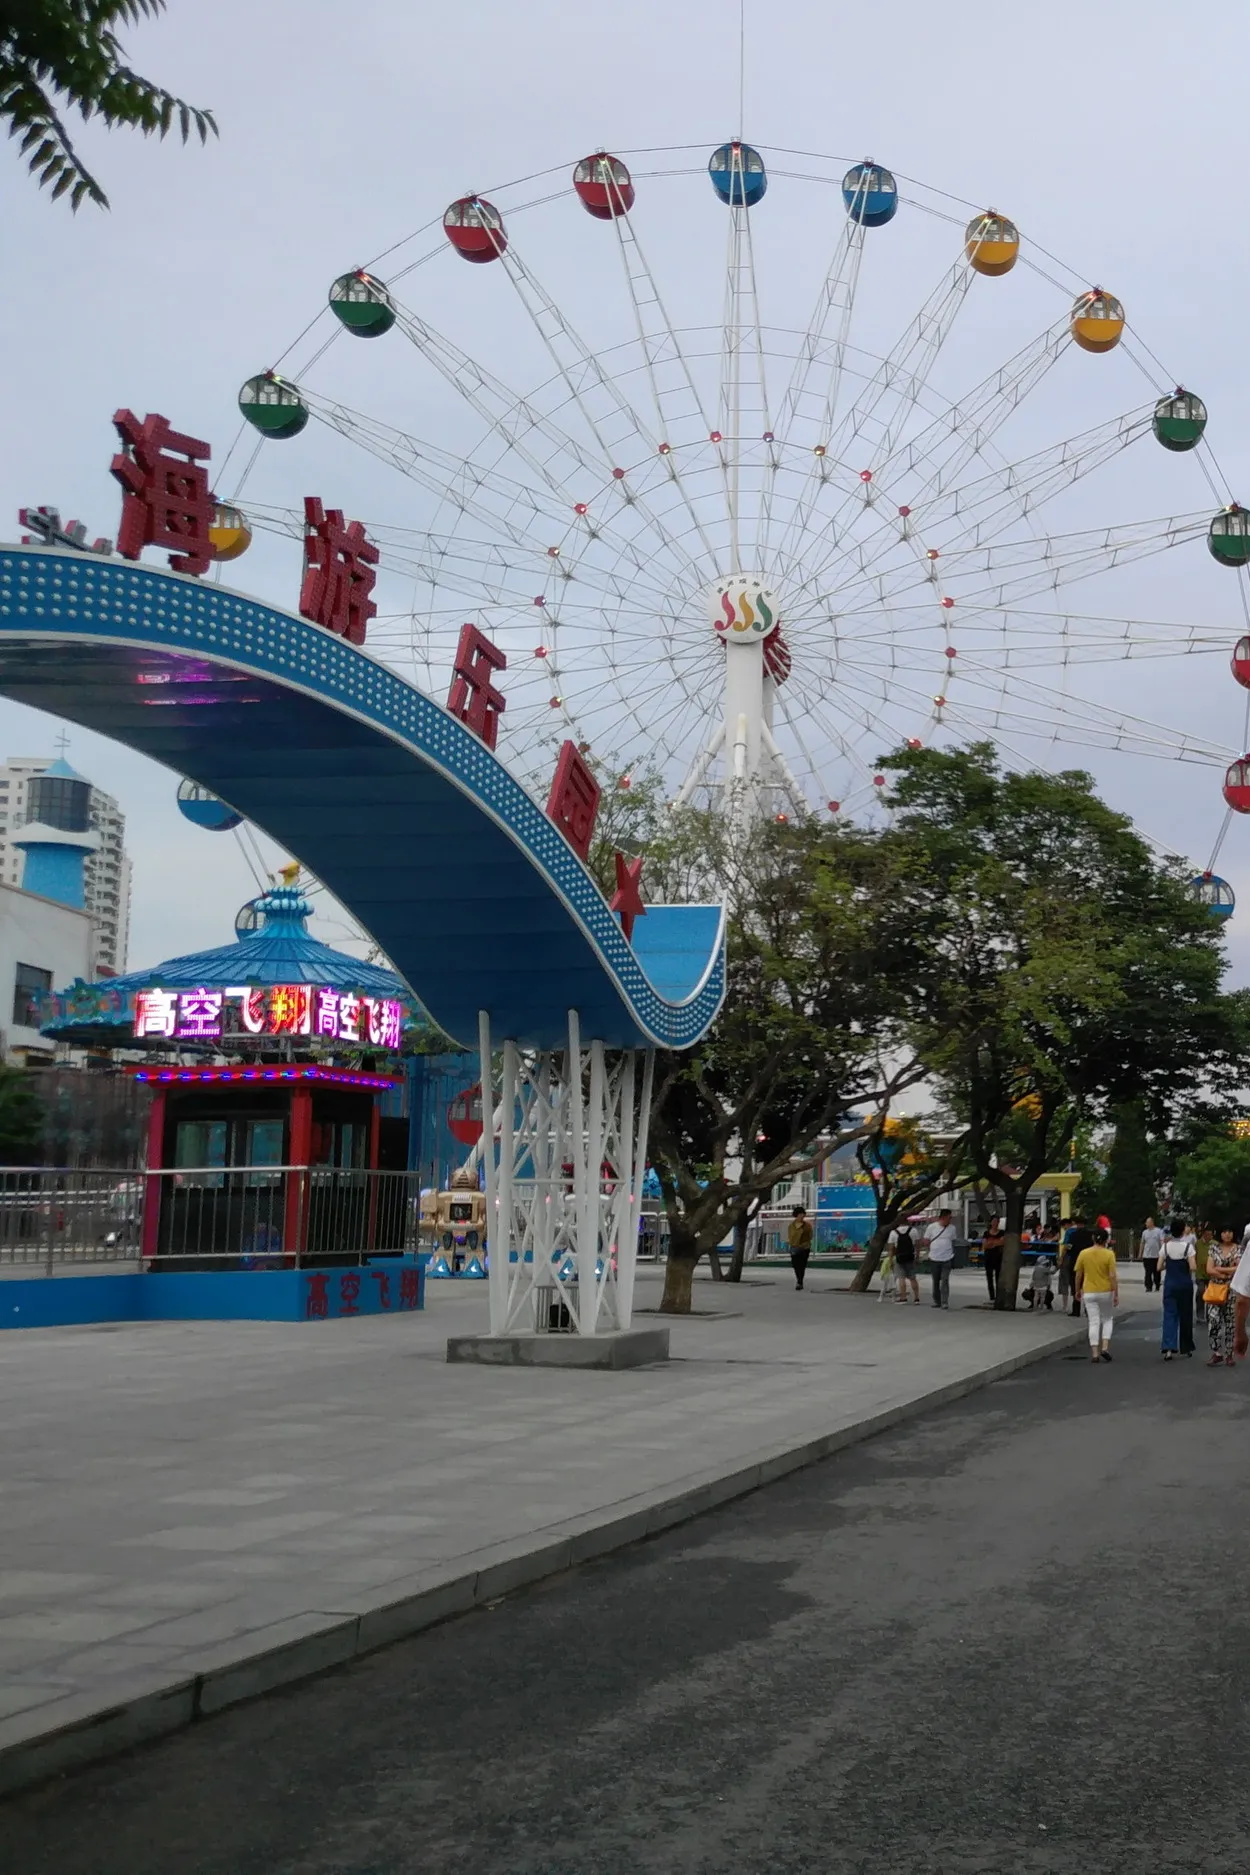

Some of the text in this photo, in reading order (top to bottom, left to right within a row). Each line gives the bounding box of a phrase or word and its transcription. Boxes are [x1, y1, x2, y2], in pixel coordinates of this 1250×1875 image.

[134, 984, 313, 1038] 高空飞翔
[317, 986, 402, 1049] 高空飞翔
[305, 1267, 421, 1321] 高空飞翔
